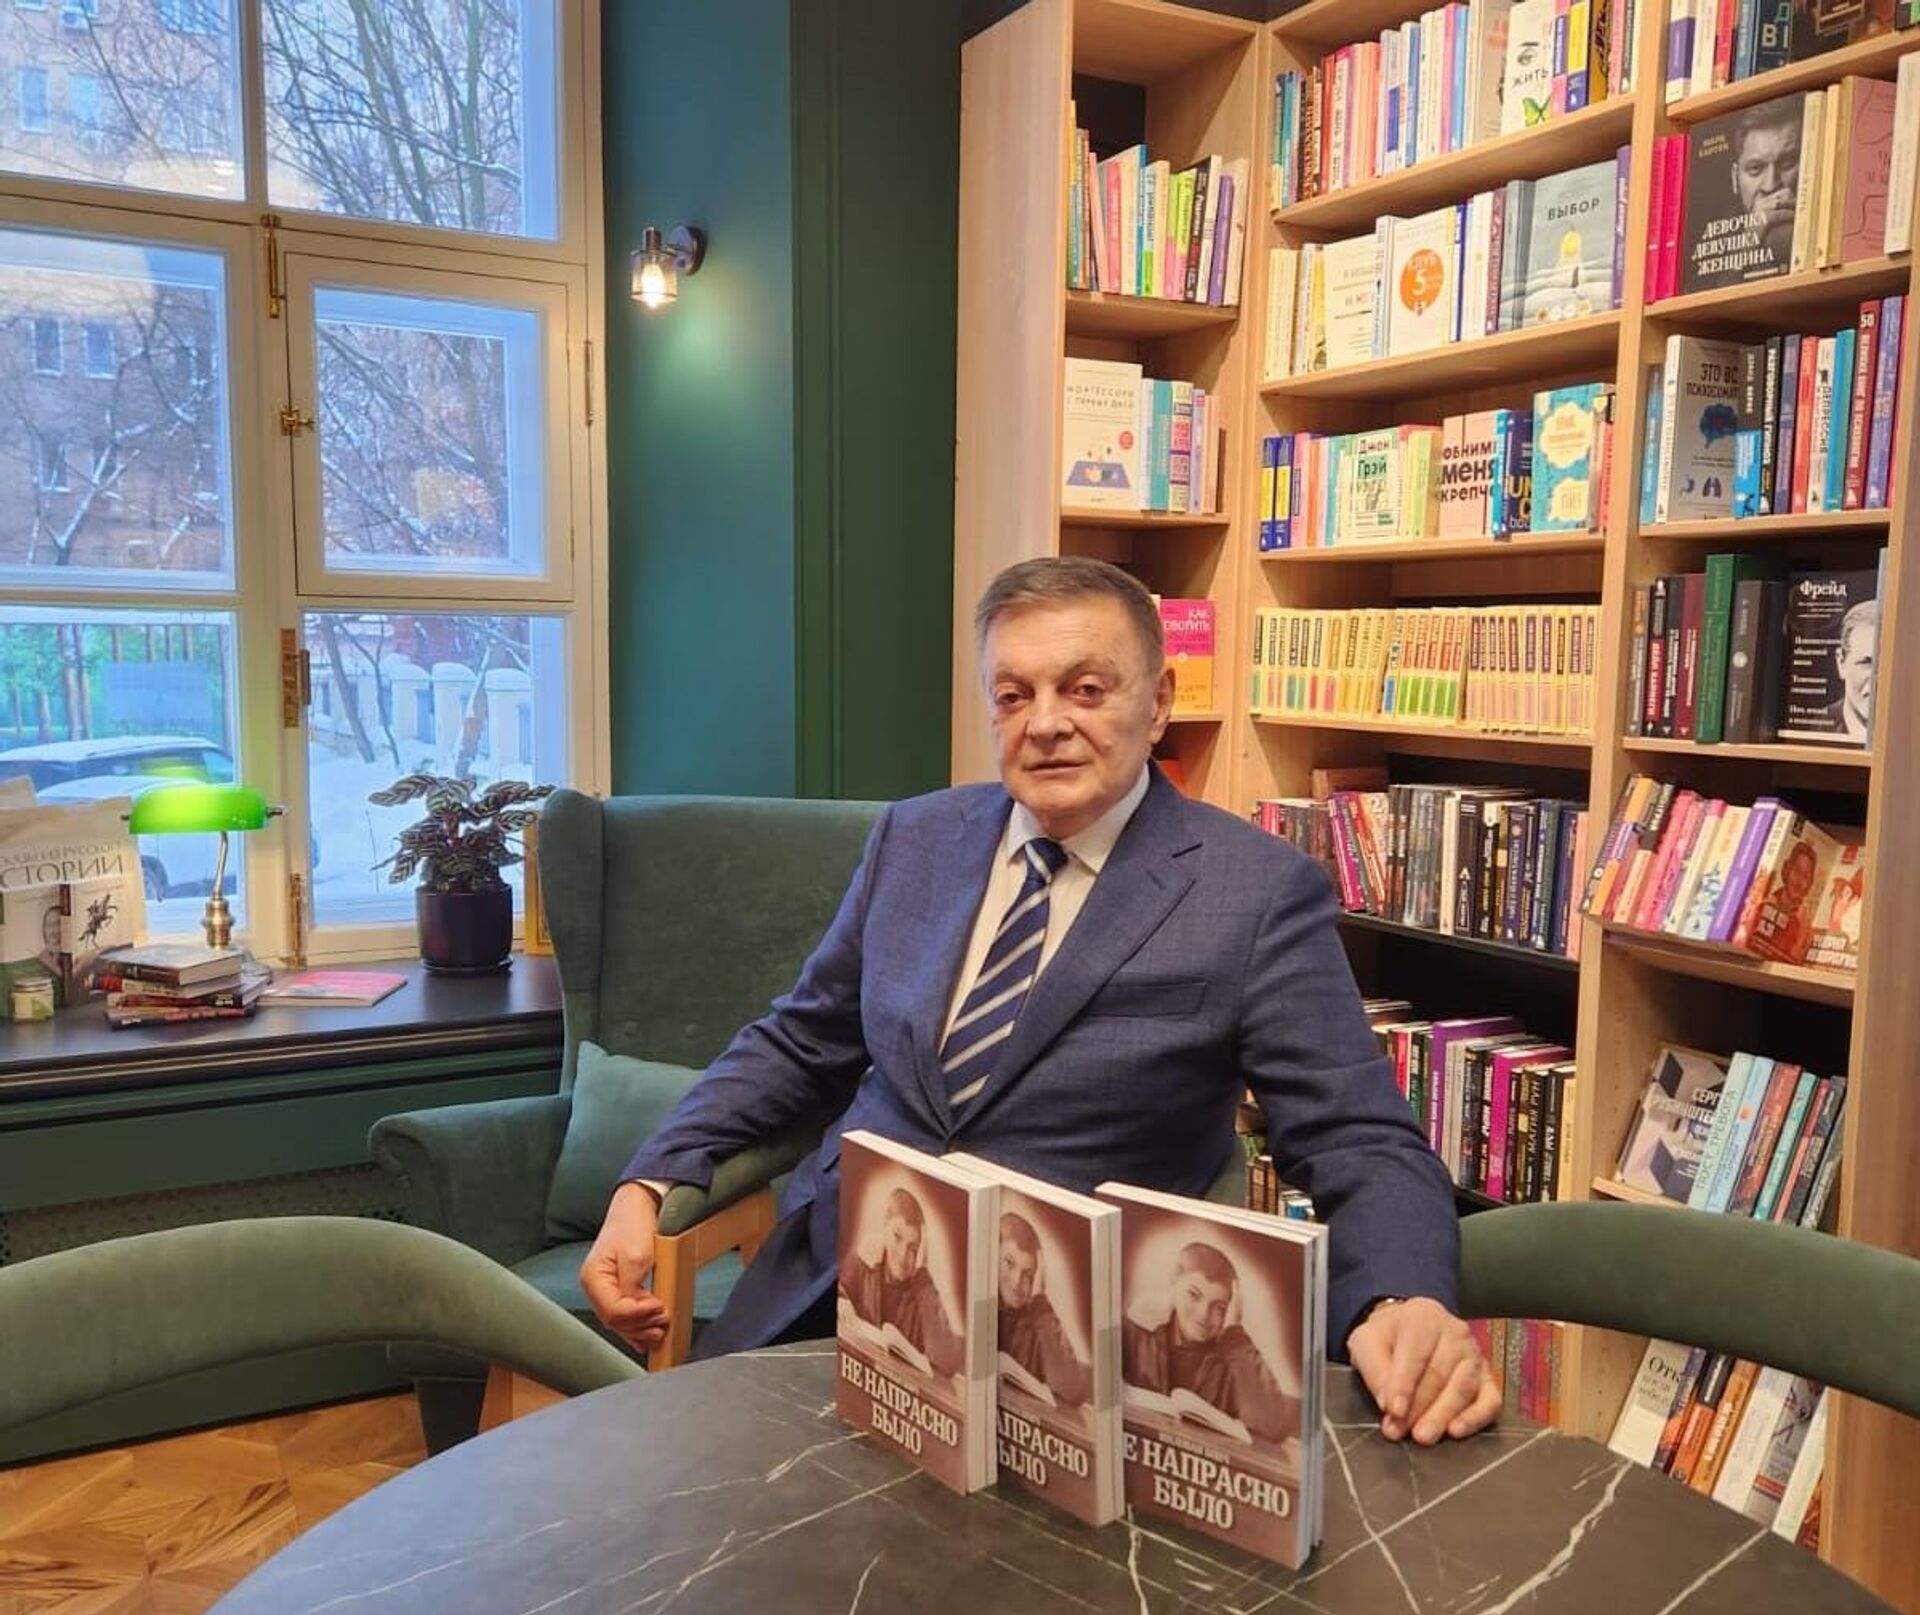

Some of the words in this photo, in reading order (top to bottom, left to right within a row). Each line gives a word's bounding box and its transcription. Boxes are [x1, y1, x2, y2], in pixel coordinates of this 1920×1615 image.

[1512, 69, 1549, 89] ЖИТЬ
[1548, 199, 1600, 222] ВЫБОР
[1702, 211, 1768, 240] ДЕВОЧКА
[1691, 231, 1761, 260] ДЕВУШКА
[1698, 248, 1775, 276] ЖЕНЩИНА
[1860, 314, 1874, 327] 50
[1700, 363, 1721, 382] ЭТО
[1358, 455, 1388, 480] Грэй
[1800, 579, 1848, 599] Фрейд
[0, 854, 123, 889] СТОРИИ
[841, 1352, 863, 1388] НЕ
[864, 1366, 959, 1448] НАПРАСНО
[871, 1400, 923, 1456] БЫЛО
[999, 1410, 1089, 1478] ПРАСНО
[999, 1440, 1046, 1486] ЫЛО
[1123, 1432, 1138, 1462] Е
[1142, 1437, 1290, 1518] НАПРАСНО
[1154, 1474, 1234, 1530] БЫЛО
